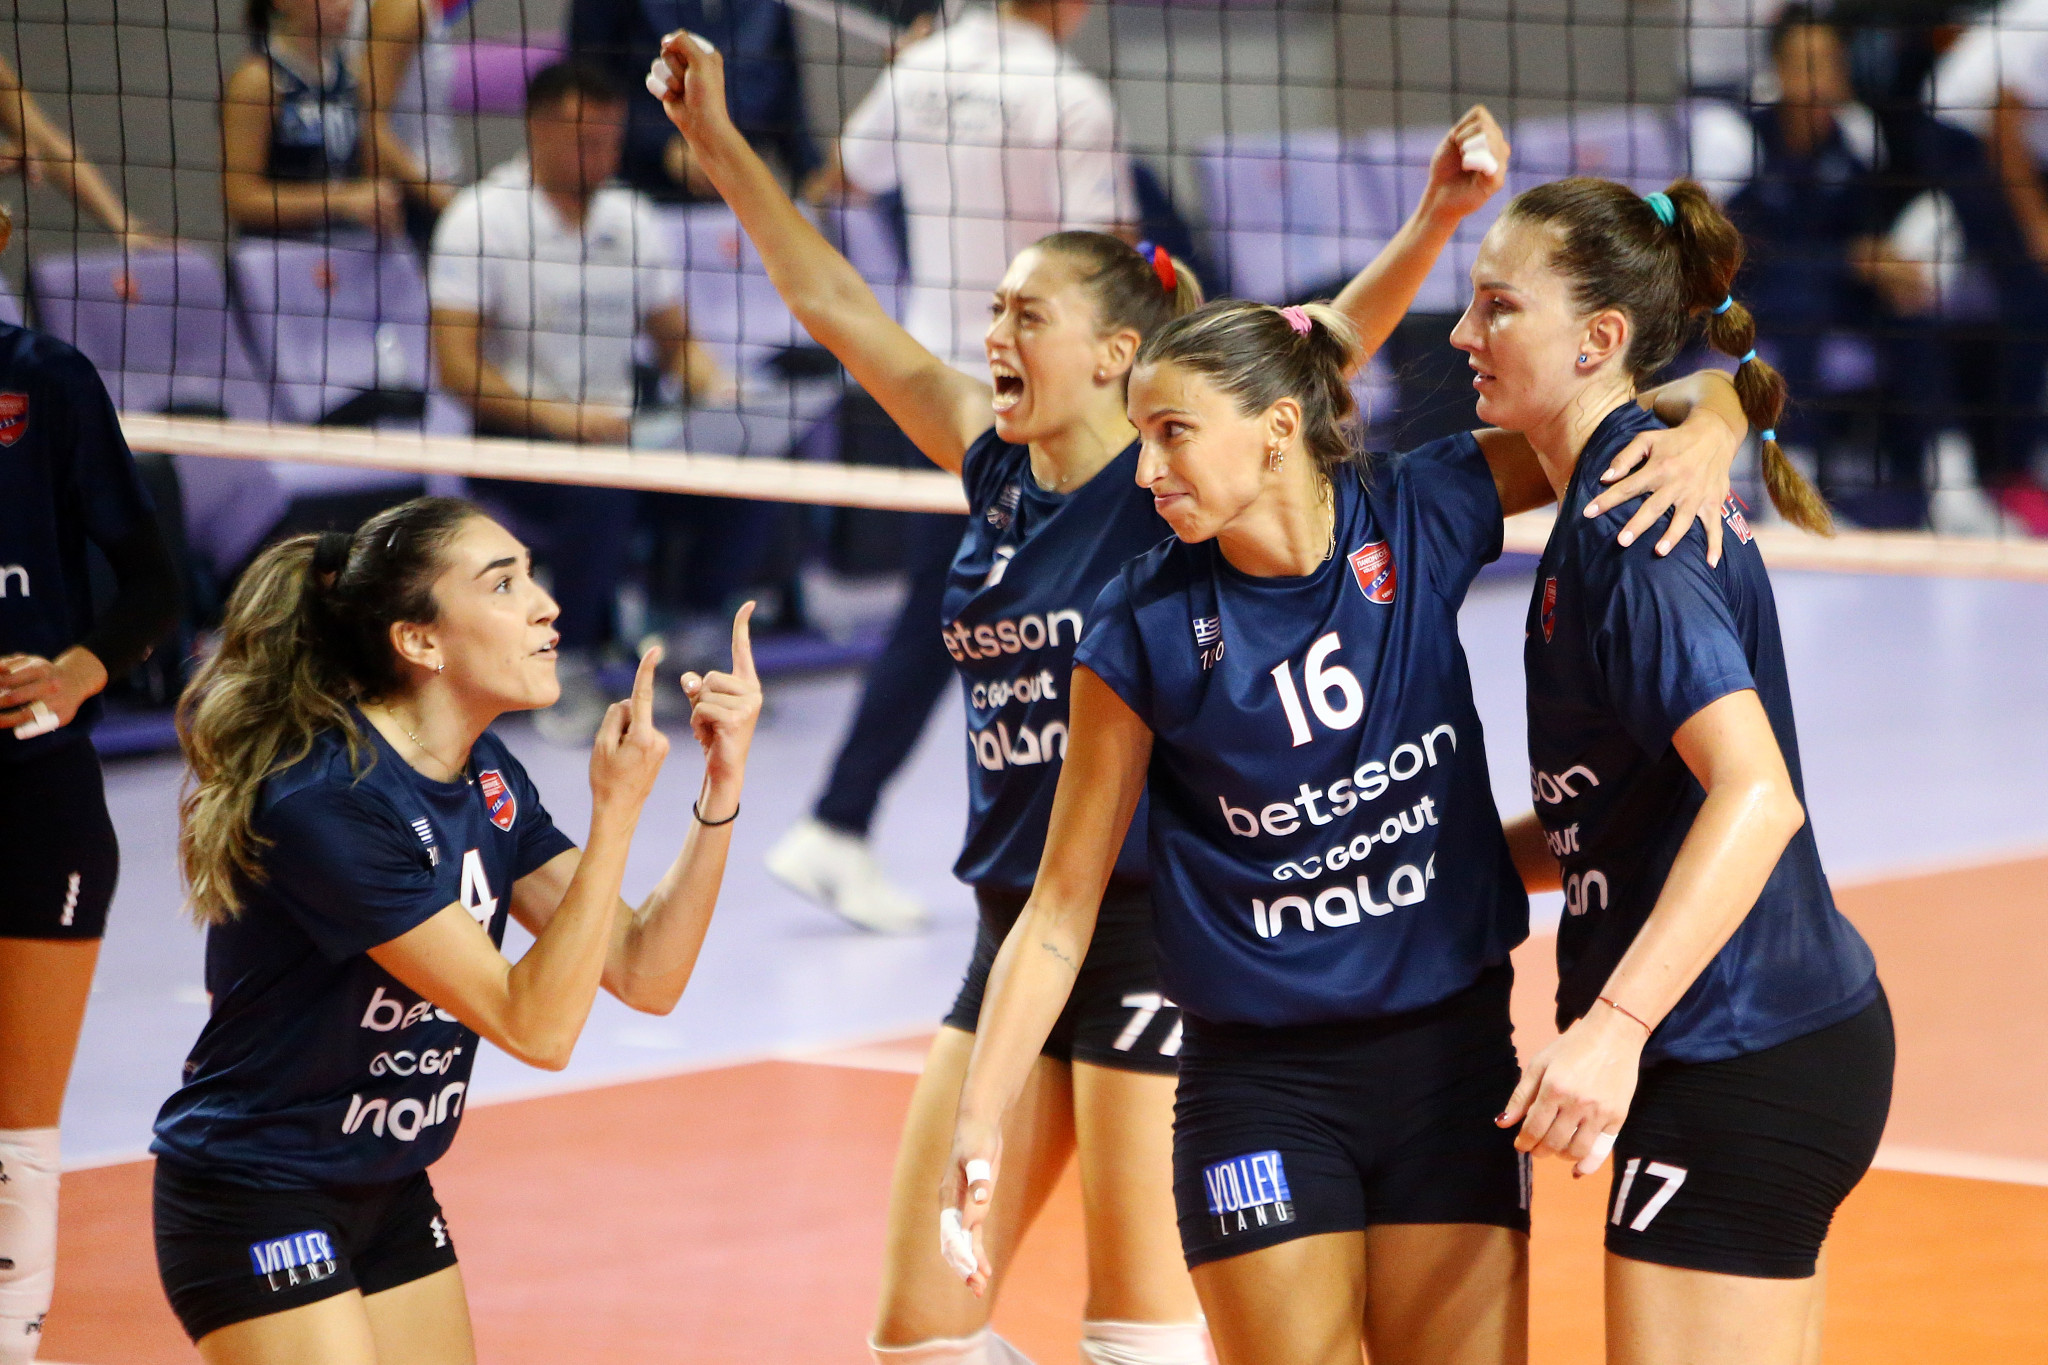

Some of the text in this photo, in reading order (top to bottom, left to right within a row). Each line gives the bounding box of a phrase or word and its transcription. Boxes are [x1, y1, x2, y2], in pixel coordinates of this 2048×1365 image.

[1270, 631, 1365, 748] 16
[1218, 723, 1457, 838] betsson
[459, 848, 499, 936] 4
[1206, 1152, 1283, 1214] VOLLEY
[1610, 1156, 1688, 1233] 17
[1220, 1201, 1288, 1236] LAND
[253, 1232, 336, 1275] VOLLEY
[267, 1259, 338, 1292] LAND
